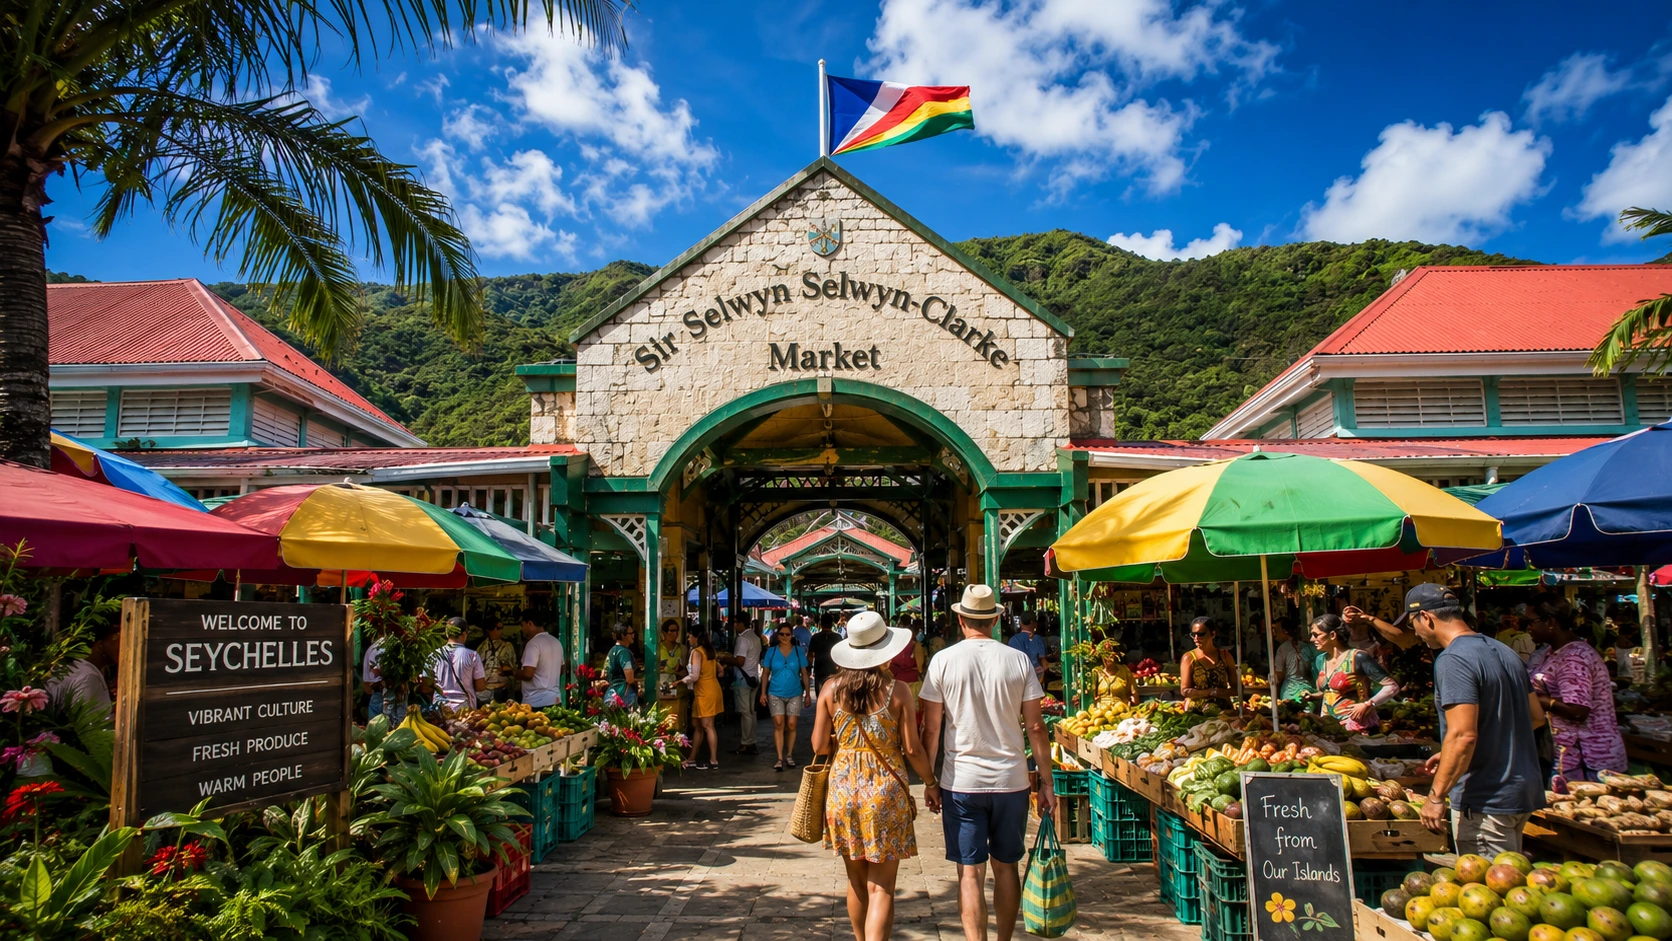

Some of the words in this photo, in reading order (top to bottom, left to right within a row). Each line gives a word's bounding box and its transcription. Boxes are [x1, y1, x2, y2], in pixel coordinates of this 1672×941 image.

[633, 329, 679, 374] Sir
[682, 281, 792, 340] Selwyn
[802, 271, 1010, 370] Selwyn-Clarke
[768, 342, 882, 371] Market
[201, 614, 282, 631] WELCOME
[288, 615, 308, 631] TO
[164, 640, 334, 674] SEYCHELLES
[188, 705, 252, 726] VIBRANT
[257, 700, 314, 718] CULTURE
[192, 741, 240, 762] FRESH
[246, 731, 309, 754] PRODUCE
[198, 774, 246, 797] WARM
[252, 764, 303, 787] PEOPLE
[1260, 794, 1312, 819] Fresh
[1274, 826, 1318, 855] from
[1262, 859, 1289, 880] Our
[1291, 861, 1341, 883] Islands
